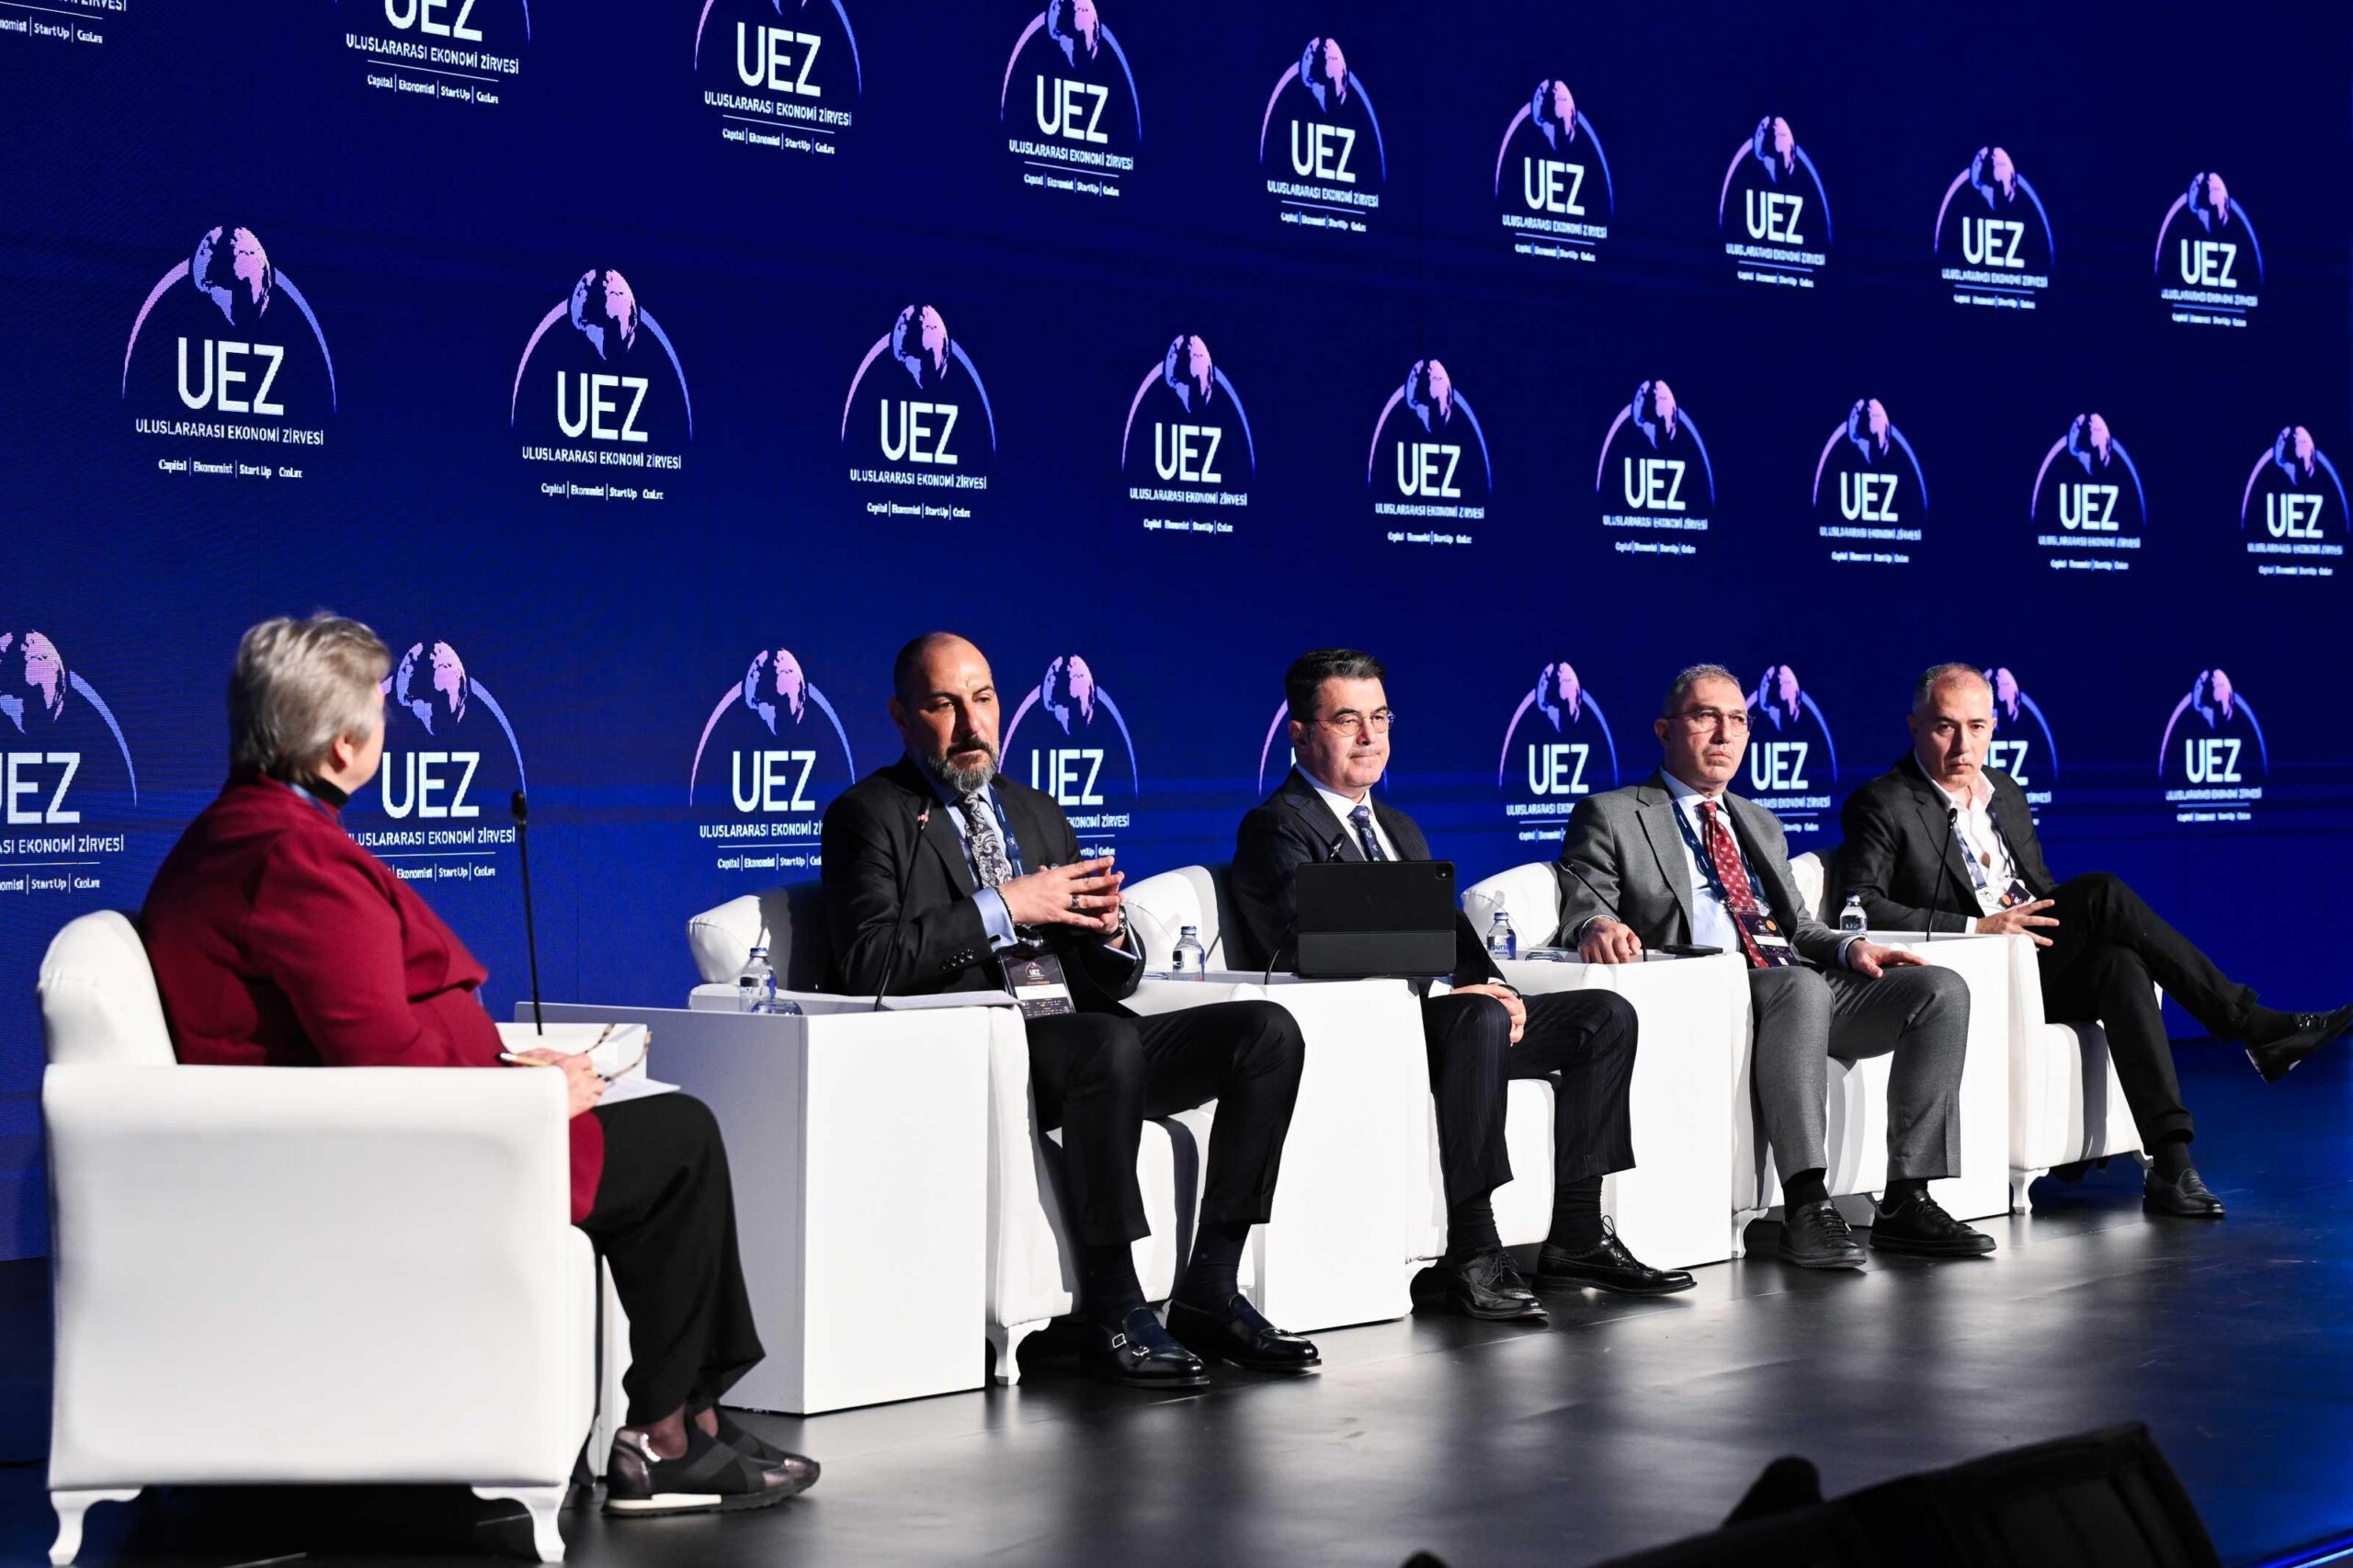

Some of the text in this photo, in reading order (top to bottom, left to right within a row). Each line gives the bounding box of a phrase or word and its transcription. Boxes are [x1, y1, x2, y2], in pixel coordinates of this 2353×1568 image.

[0, 18, 27, 32] nomist
[34, 23, 69, 40] StartUp
[347, 34, 518, 74] ULUSLARARASI EKONOMİ ZİRVESİ
[738, 22, 821, 97] UEZ
[368, 75, 393, 88] Capital
[399, 80, 435, 94] Ekonomist
[441, 86, 471, 100] StartUp
[705, 91, 851, 126] ULUSLARARASI EKONOMİ ZİRVESİ
[1037, 75, 1108, 143] UEZ
[1009, 140, 1133, 170] ULUSLARARASI EKONOMİ ZİRVESİ
[1292, 120, 1355, 182] UEZ
[1525, 157, 1585, 215] UEZ
[1746, 189, 1802, 244] UEZ
[1963, 217, 2024, 267] UEZ
[2181, 239, 2236, 288] UEZ
[178, 337, 283, 415] UEZ
[558, 371, 648, 441] UEZ
[136, 419, 323, 445] ULUSLARARASI EKONOMİ ZİRVESİ
[881, 400, 958, 464] UEZ
[1155, 423, 1221, 483] UEZ
[159, 460, 187, 473] Capital
[194, 461, 233, 473] Ekonomist
[240, 464, 271, 478] StartUp
[523, 447, 681, 469] ULUSLARARASI EKONOMİ ZİRVESİ
[850, 469, 986, 489] ULUSLARARASI EKONOMİ ZİRVESİ
[1398, 442, 1461, 497] UEZ
[1625, 458, 1685, 510] UEZ
[1841, 472, 1898, 521] UEZ
[2060, 483, 2119, 530] UEZ
[2268, 494, 2323, 538] UEZ
[733, 751, 815, 812] UEZ
[1032, 749, 1103, 805] UEZ
[1529, 744, 1588, 795] UEZ
[1751, 743, 1808, 790] UEZ
[1984, 741, 2029, 786] EZ
[2187, 739, 2241, 783] UEZ
[0, 753, 80, 824] EZ
[382, 752, 479, 818] UEZ
[346, 827, 515, 846] USLARARASI EKONOMİ ZİRVESİ
[700, 824, 768, 837] ULUSLARARASI
[772, 821, 811, 835] EKONOMİ
[1101, 813, 1129, 827] ZİRVESİ
[19, 835, 74, 853] EKONOMİ
[79, 835, 123, 852] ZİRVESİ
[718, 858, 739, 869] Capital
[780, 858, 805, 867] StartUp
[0, 879, 24, 891] omist
[31, 879, 66, 890] StartUp
[396, 867, 433, 879] Ekonomist
[439, 868, 468, 878] StartUp
